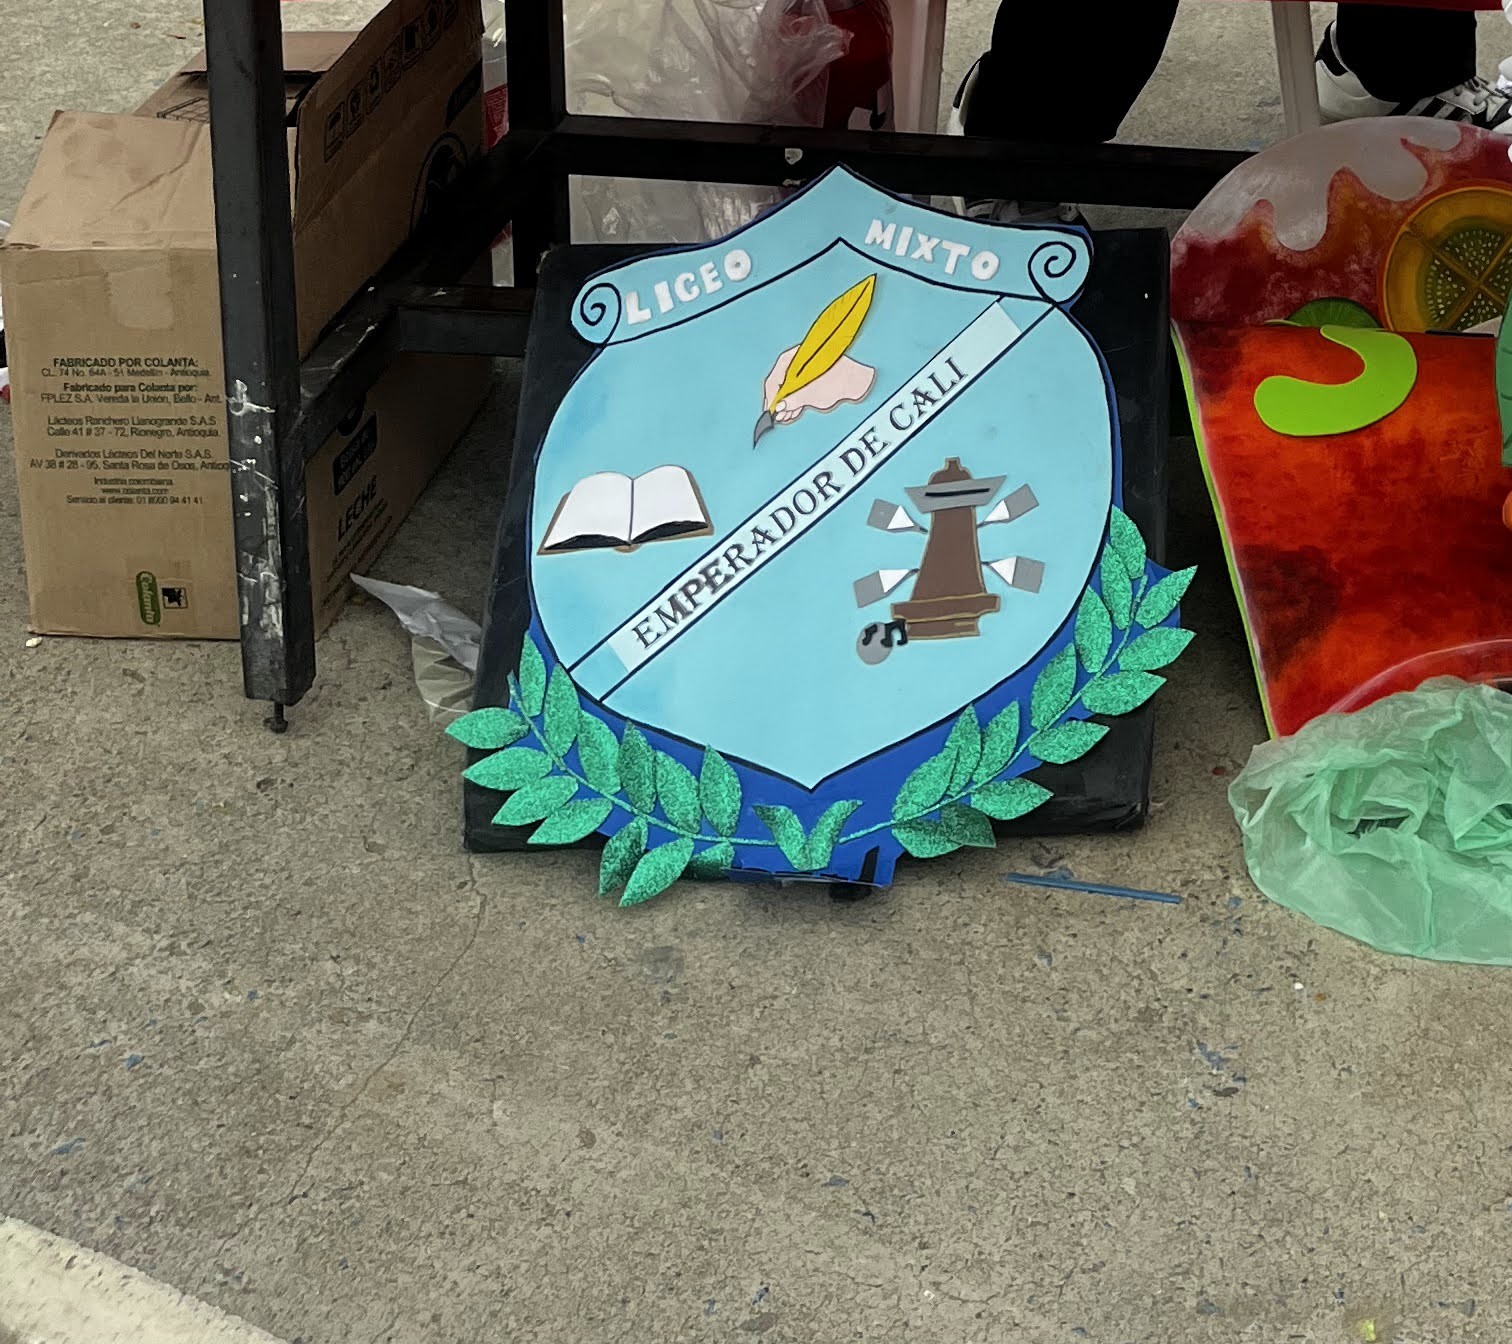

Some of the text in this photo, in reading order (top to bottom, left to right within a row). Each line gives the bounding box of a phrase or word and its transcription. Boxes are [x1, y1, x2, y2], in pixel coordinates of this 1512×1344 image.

[625, 219, 1001, 325] LICEO MIXTO
[54, 357, 198, 367] FABRICADO POR COLANTA:
[63, 382, 112, 392] Fabricado
[631, 357, 970, 651] EMPERADOR DE CALI
